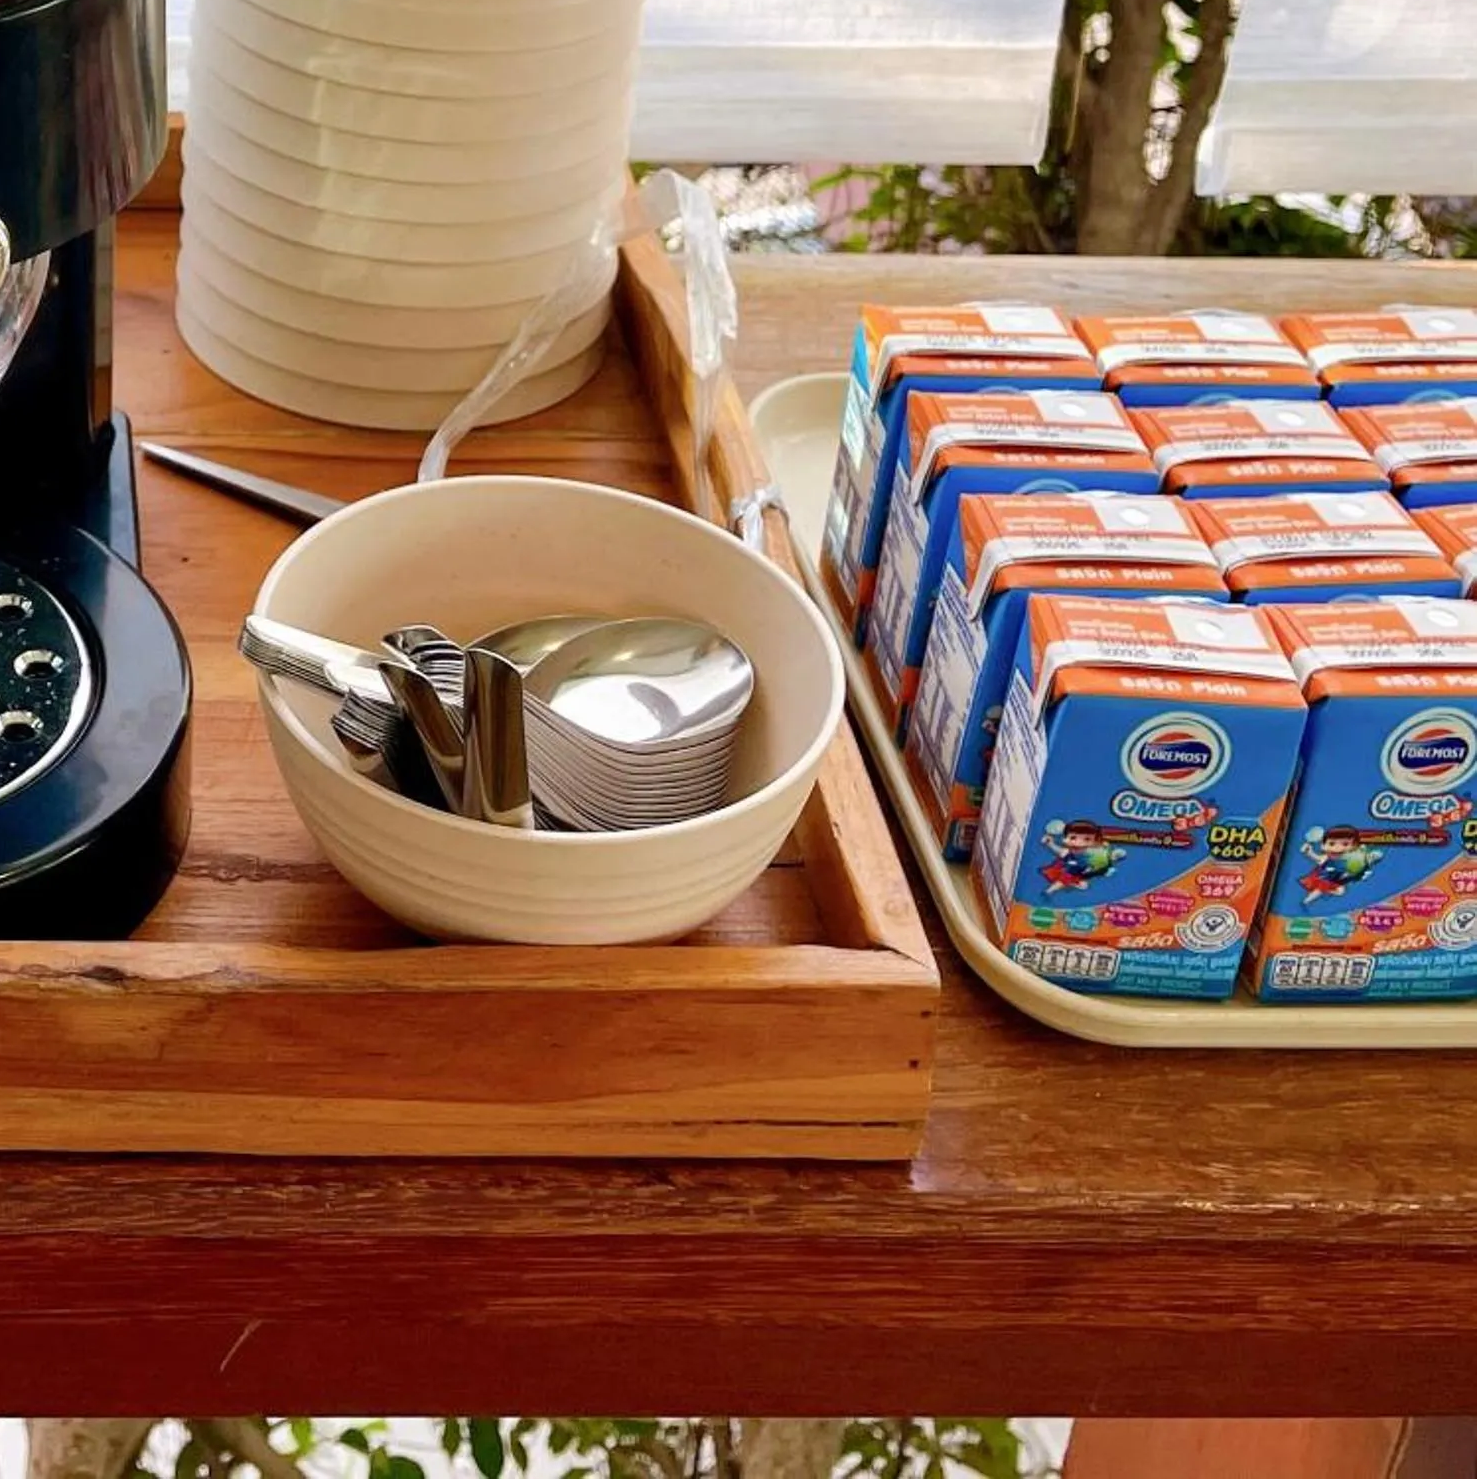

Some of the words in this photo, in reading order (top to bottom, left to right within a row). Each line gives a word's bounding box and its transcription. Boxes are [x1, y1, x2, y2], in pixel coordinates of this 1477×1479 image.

[1190, 679, 1249, 697] Plain
[1142, 747, 1210, 765] FOREMOST
[1401, 746, 1466, 761] FOREMOST
[1116, 793, 1204, 819] OMEGA
[1375, 794, 1459, 818] OMEGA
[1209, 825, 1265, 844] DHA
